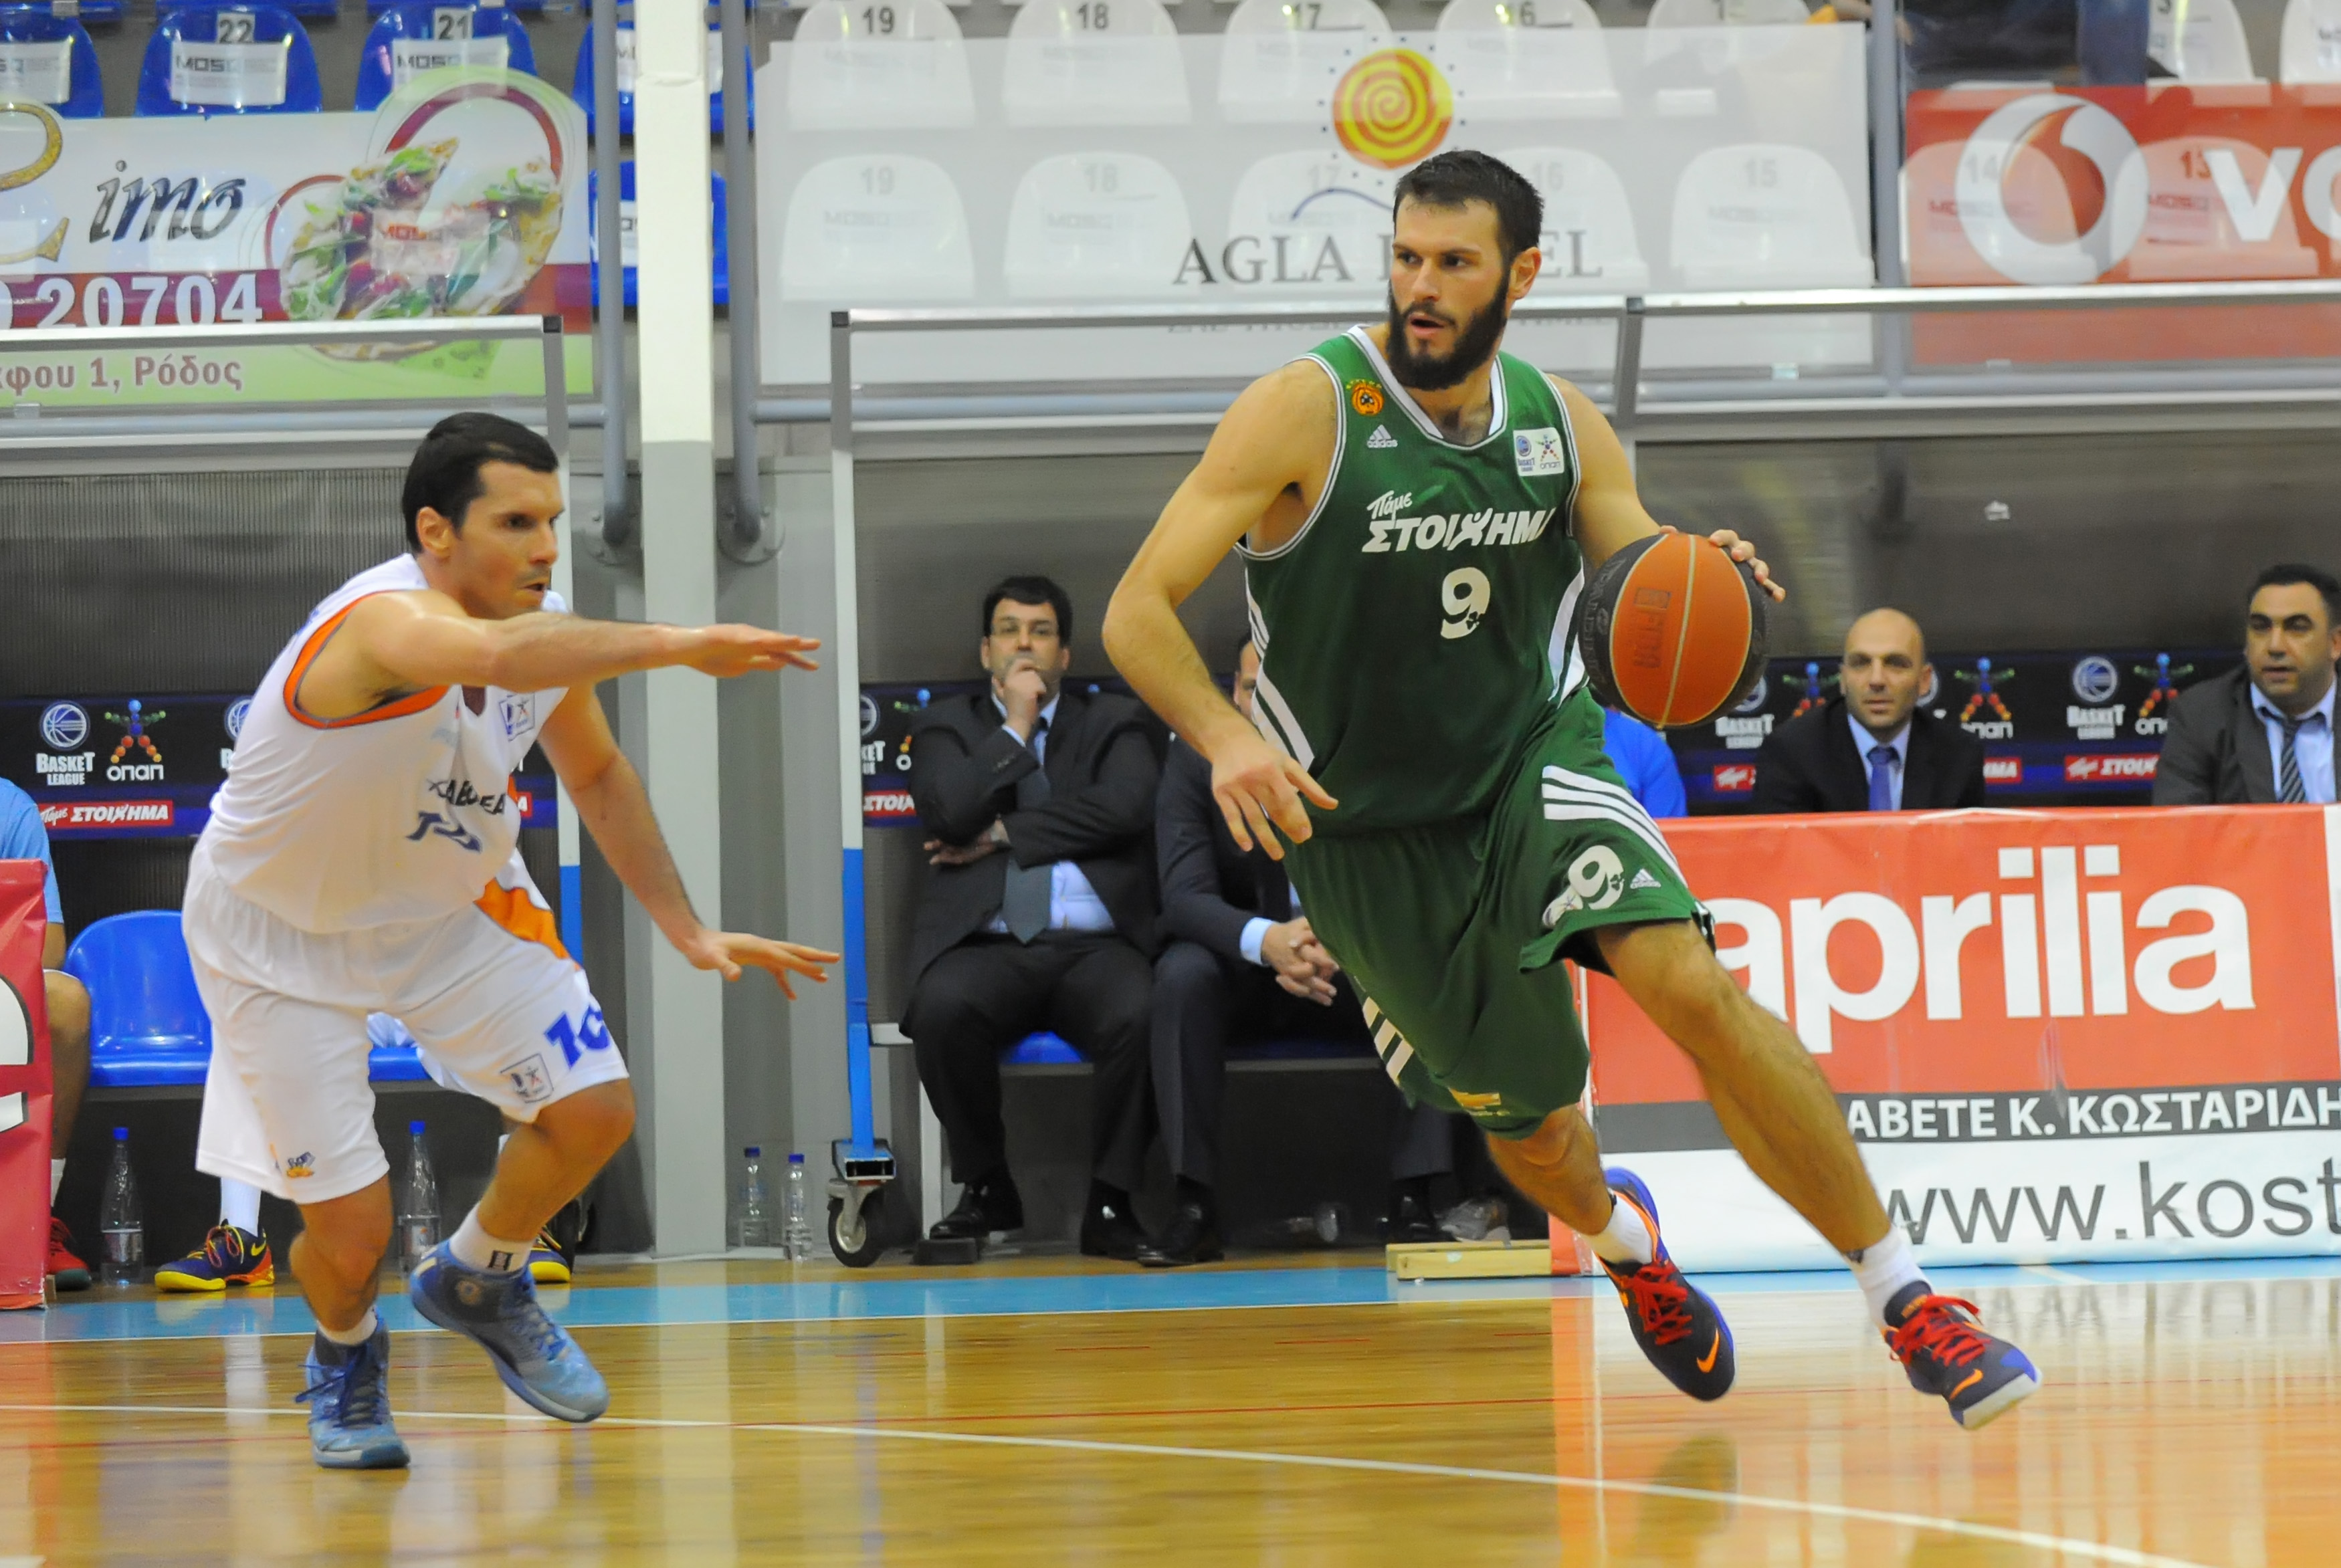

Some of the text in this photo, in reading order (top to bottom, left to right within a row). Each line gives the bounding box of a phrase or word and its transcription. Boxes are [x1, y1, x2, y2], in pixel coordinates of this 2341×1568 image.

[438, 15, 468, 40] 21
[862, 7, 894, 34] 19
[1076, 3, 1109, 29] 18
[1293, 3, 1321, 29] 17
[219, 19, 253, 43] 22
[860, 166, 894, 195] 19
[1084, 164, 1118, 193] 18
[1744, 157, 1778, 188] 15
[1173, 235, 1353, 285] AGLA
[36, 273, 263, 328] 20704
[0, 353, 242, 396] φου 1, Ρόδος
[1441, 567, 1491, 639] 9
[36, 752, 95, 774] BASKET
[47, 772, 85, 786] LEAGUE
[1568, 845, 1624, 910] 9
[1709, 845, 2255, 1054] aprilia
